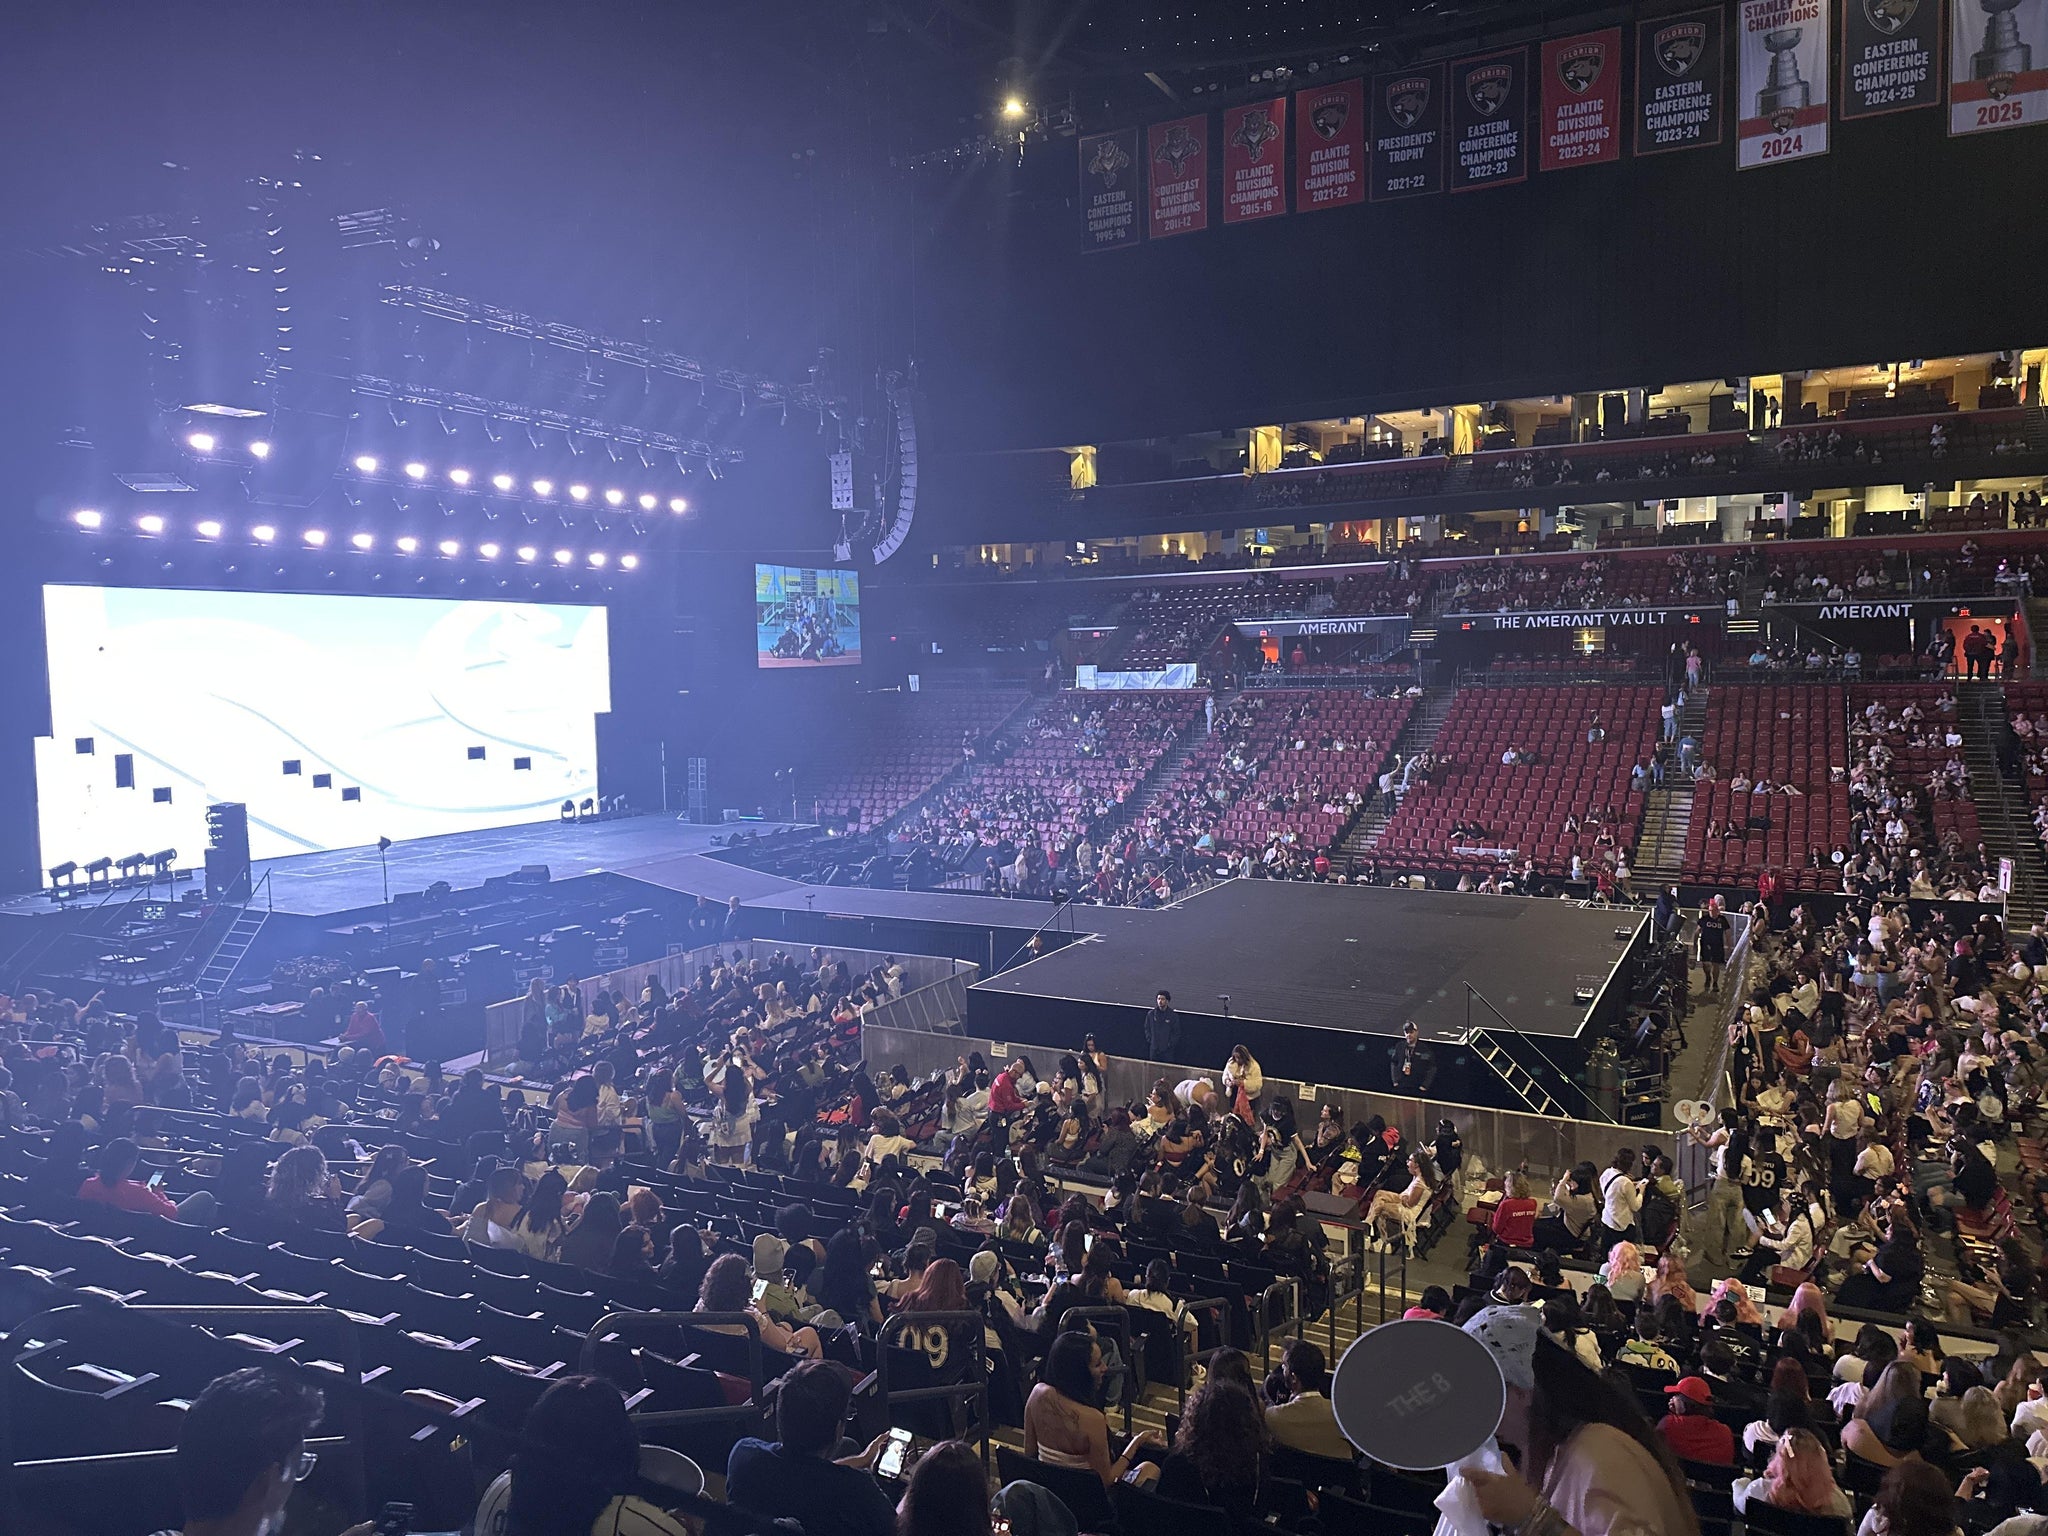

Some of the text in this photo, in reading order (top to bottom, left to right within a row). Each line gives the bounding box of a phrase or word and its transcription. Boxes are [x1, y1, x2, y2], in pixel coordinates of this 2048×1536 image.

[1745, 0, 1793, 19] STANLEY
[1748, 5, 1819, 32] CHAMPIONS
[1864, 38, 1918, 59] EASTERN
[1853, 51, 1929, 77] CONFERENCE
[1855, 67, 1927, 92] CHAMPIONS
[1655, 80, 1703, 100] EASTERN
[1865, 86, 1916, 106] 2024-25
[1557, 99, 1604, 118] ATLANTIC
[1645, 94, 1712, 116] CONFERENCE
[1977, 101, 2023, 126] 2025
[1467, 119, 1510, 138] EASTERN
[1557, 113, 1603, 132] DIVISION
[1647, 109, 1710, 130] CHAMPIONS
[1378, 131, 1436, 151] PRESIDENTS'
[1459, 131, 1518, 153] CONFERENCE
[1550, 126, 1609, 147] CHAMPIONS
[1655, 125, 1700, 143] 2023-24
[1310, 144, 1350, 163] ATLANTIC
[1389, 147, 1424, 163] TROPHY
[1460, 146, 1516, 167] CHAMPIONS
[1558, 142, 1600, 160] 2023-24
[1762, 135, 1802, 159] 2024
[1235, 164, 1274, 181] ATLANTIC
[1311, 159, 1350, 176] DIVISION
[1469, 162, 1508, 179] 2022-23
[1155, 178, 1199, 197] SOUTHEAST
[1236, 175, 1273, 192] DIVISION
[1305, 170, 1356, 191] CHAMPIONS
[1387, 175, 1425, 191] 2021-22
[1094, 190, 1126, 205] EASTERN
[1161, 191, 1195, 206] DIVISION
[1230, 186, 1279, 204] CHAMPIONS
[1312, 185, 1349, 202] 2021-22
[1087, 201, 1133, 219] CONFERENCE
[1155, 201, 1200, 220] CHAMPIONS
[1240, 201, 1272, 215] 2015-16
[1089, 215, 1132, 232] CHAMPIONS
[1164, 217, 1191, 231] 2011-12
[1095, 228, 1126, 243] 1995-96
[1493, 611, 1667, 629] THE AMERANT VAULT
[1819, 603, 1914, 619] AMERANT
[1298, 621, 1367, 634] AMERANT
[1749, 1168, 1776, 1188] 09
[897, 1325, 948, 1368] 09
[1385, 1372, 1451, 1416] THE 8
